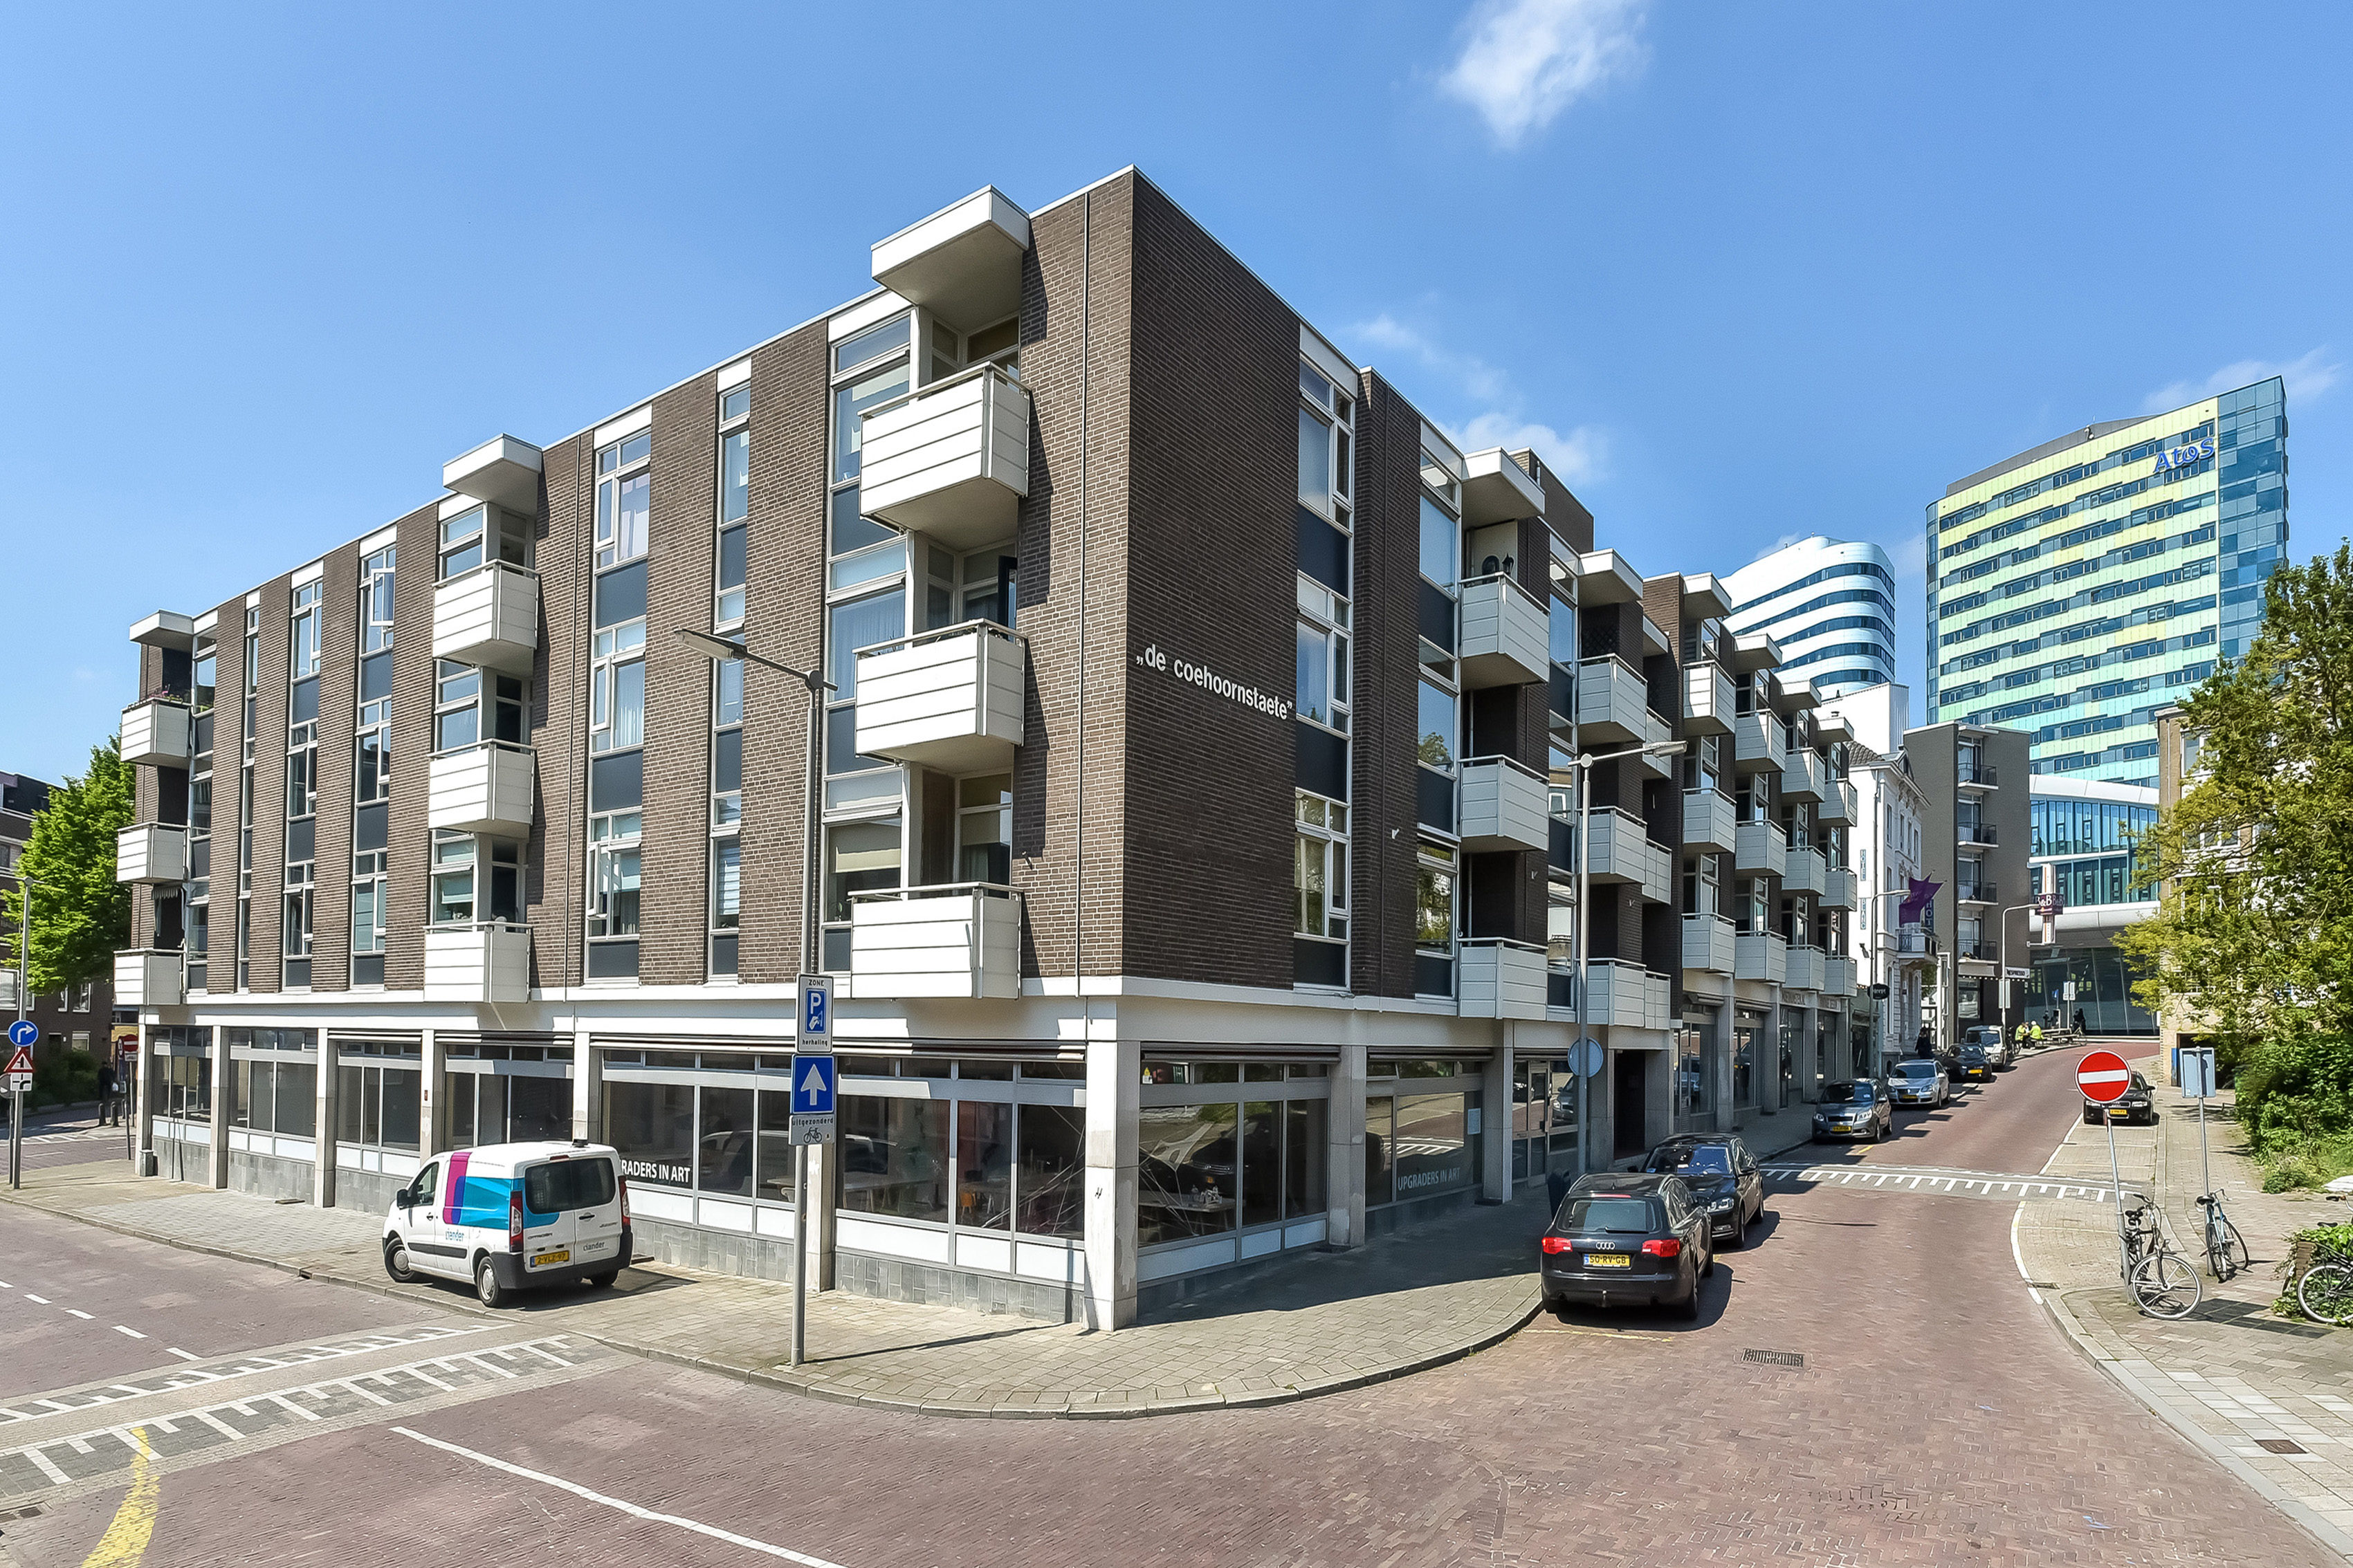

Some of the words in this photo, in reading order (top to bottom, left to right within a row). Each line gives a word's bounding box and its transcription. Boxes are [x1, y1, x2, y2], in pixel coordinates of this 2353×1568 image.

[2153, 437, 2215, 473] Atos
[2035, 894, 2052, 907] B&B
[810, 993, 822, 1015] P
[802, 1038, 828, 1046] herhaling
[792, 1117, 834, 1127] uitgezonderd
[659, 1164, 669, 1180] IN
[670, 1165, 690, 1183] ART
[1398, 1170, 1439, 1191] UPGRADERS
[1440, 1169, 1447, 1183] IN
[1447, 1167, 1461, 1182] ART
